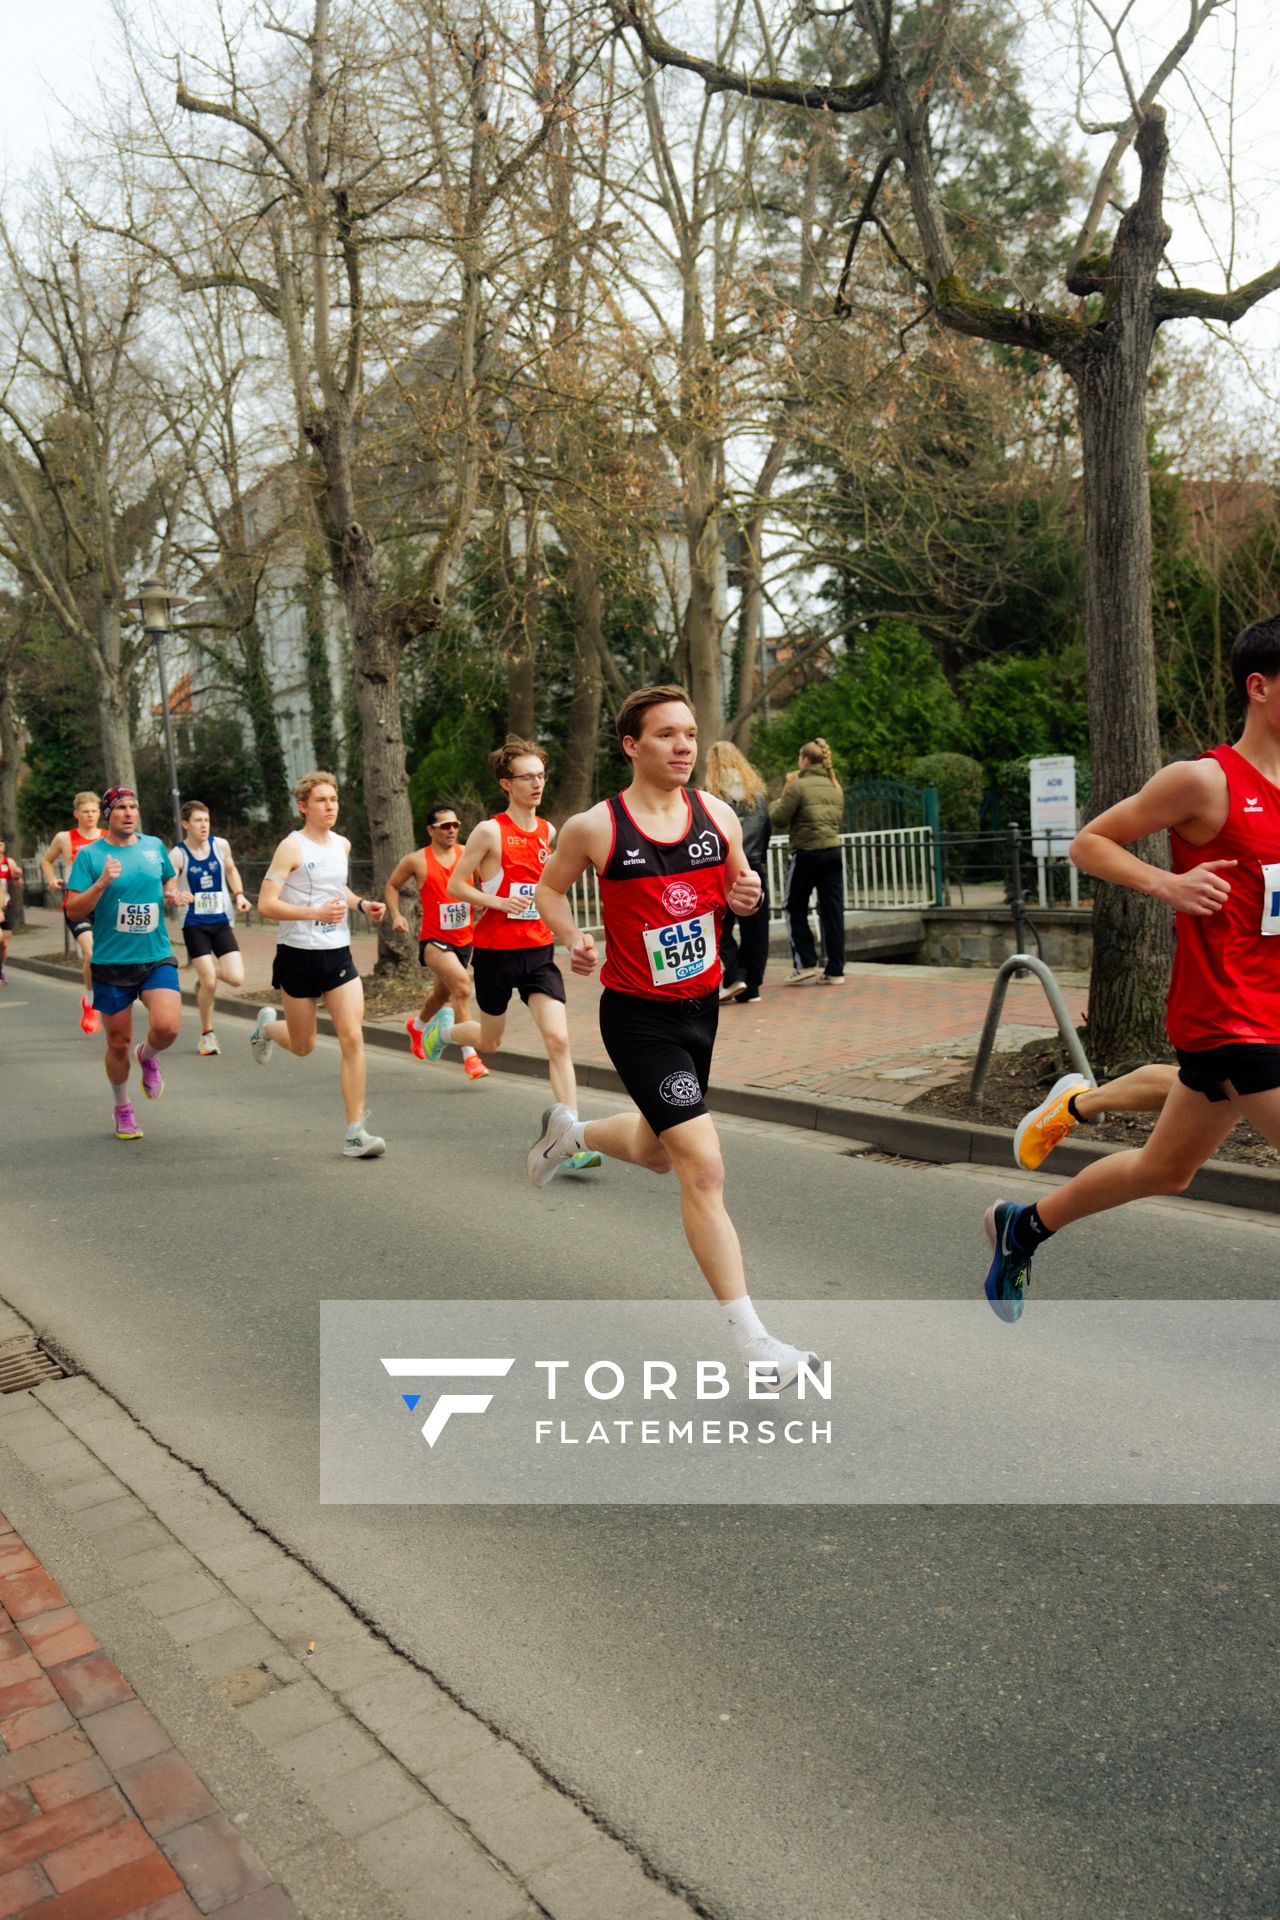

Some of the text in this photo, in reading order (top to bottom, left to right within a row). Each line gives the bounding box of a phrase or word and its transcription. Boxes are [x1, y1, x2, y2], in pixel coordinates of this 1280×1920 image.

[688, 841, 712, 858] OS
[623, 858, 646, 866] erima
[520, 885, 535, 896] GL
[127, 904, 150, 914] GLS
[447, 903, 466, 913] GLS
[126, 914, 151, 926] 358
[449, 911, 467, 923] 189
[659, 919, 702, 946] GLS
[665, 937, 706, 968] 549
